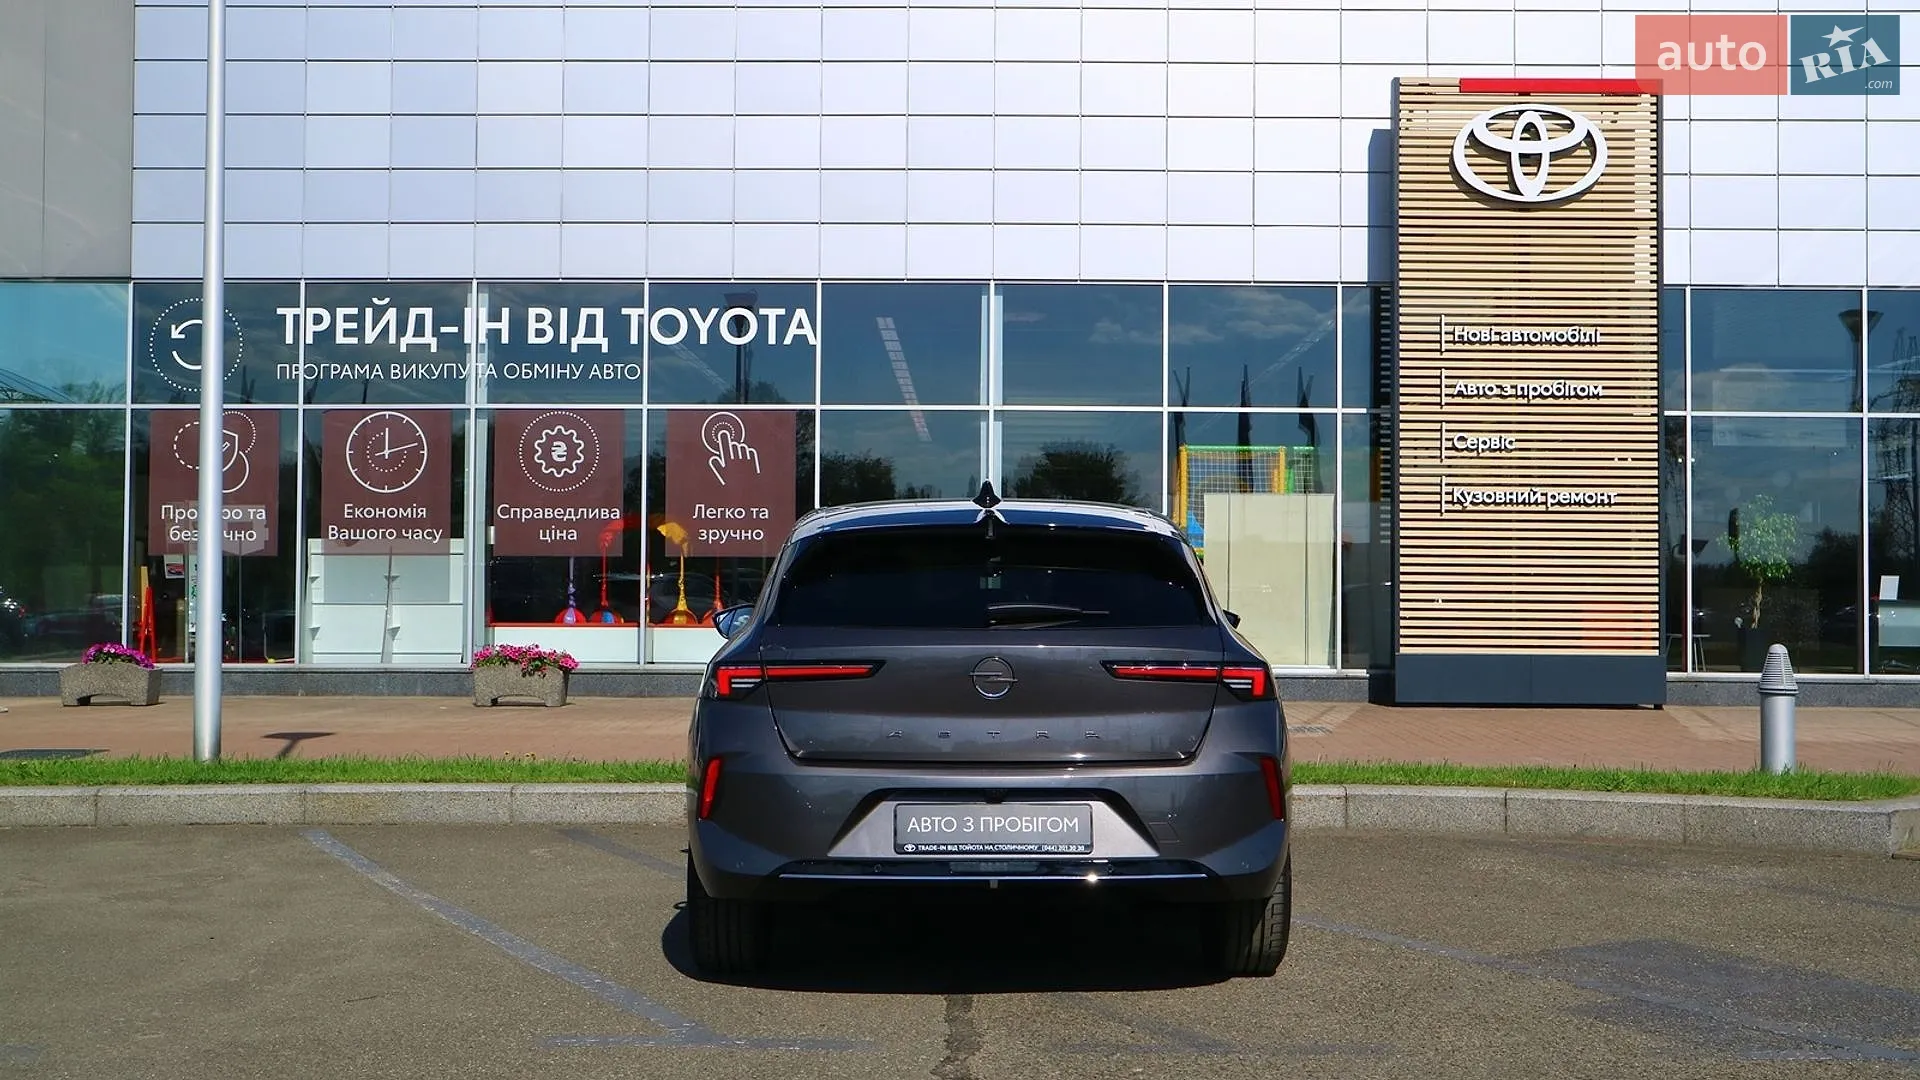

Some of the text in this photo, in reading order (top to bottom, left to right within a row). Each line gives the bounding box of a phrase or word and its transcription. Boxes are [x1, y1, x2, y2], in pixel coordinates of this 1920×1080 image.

[276, 297, 818, 353] ТРЕЙД-ІН ВІД TOYOTA
[1453, 326, 1601, 343] Нові автомобілі
[277, 363, 641, 380] ПРОГРАМА ВИКУПУ ТА ОБМІНУ АВТО
[1454, 380, 1603, 401] Авто з пробігом
[1453, 433, 1516, 451] Сервіс
[1453, 487, 1618, 507] Кузовний ремонт
[161, 505, 267, 524] Проо та
[344, 504, 427, 519] Економія
[496, 504, 621, 522] Справедлива
[692, 504, 769, 521] Легко та
[169, 525, 257, 541] безчно
[328, 525, 443, 543] Вашого часу
[539, 525, 578, 544] ціна
[698, 527, 764, 544] зручно
[887, 730, 1100, 739] ASTRA
[907, 816, 1079, 833] АВТО З ПРОБІГОМ
